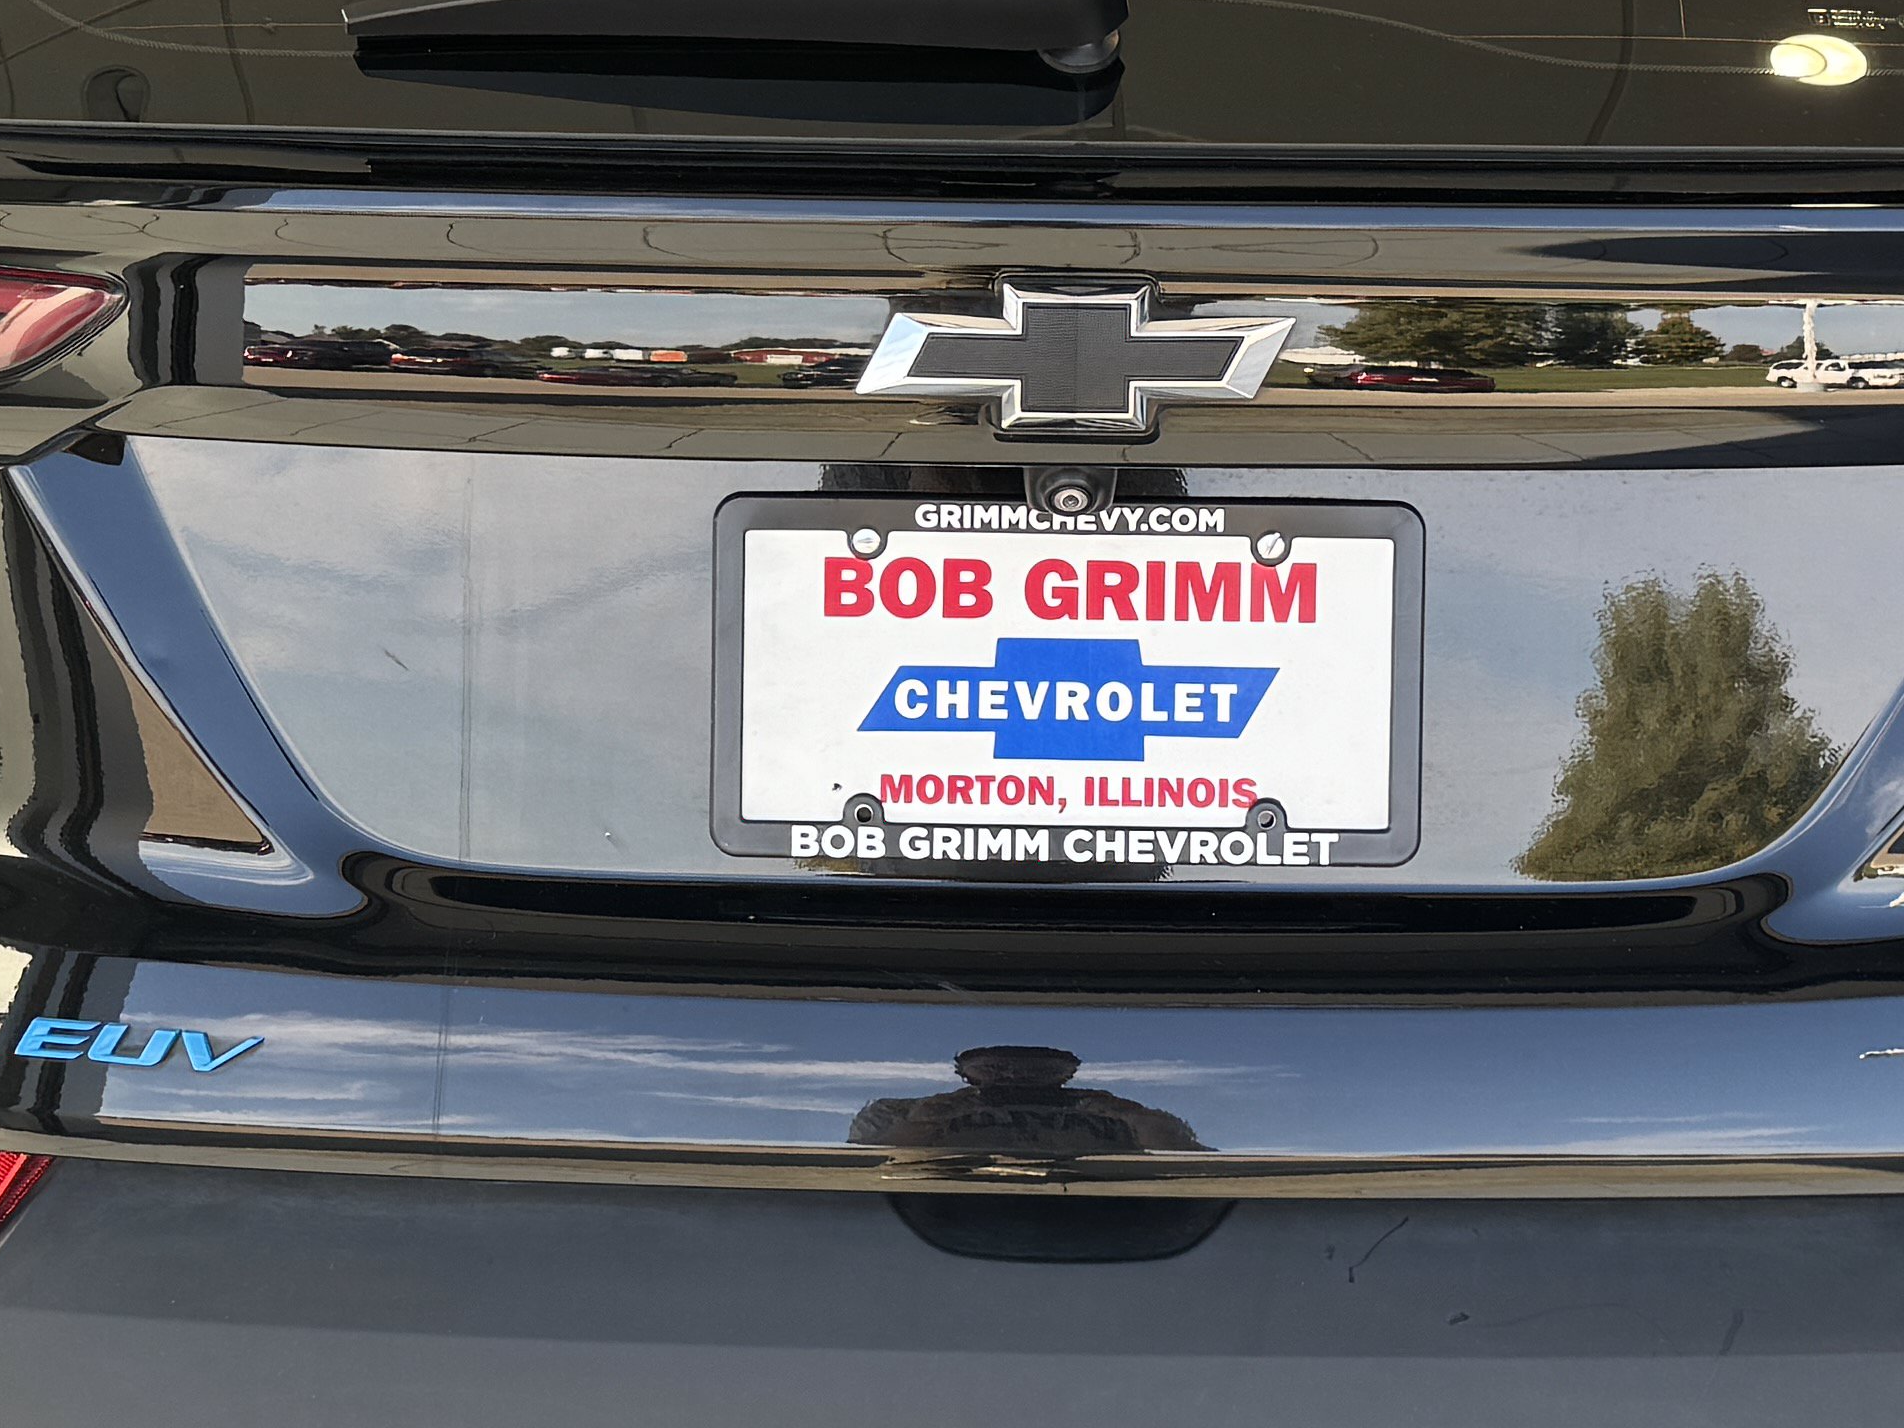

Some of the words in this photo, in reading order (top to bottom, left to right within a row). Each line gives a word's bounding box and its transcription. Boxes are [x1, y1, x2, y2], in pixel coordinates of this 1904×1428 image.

[914, 502, 1226, 533] GRIMMCHEVY.COM
[823, 556, 994, 619] BOB
[1024, 558, 1318, 623] GRIMM
[894, 678, 1238, 723] CHEVROLET
[879, 774, 1067, 814] MORTON,
[1084, 776, 1258, 809] ILLINOIS
[791, 824, 887, 860] BOB
[899, 827, 1050, 863] GRIMM
[1062, 829, 1340, 866] CHEVROLET
[14, 1015, 265, 1073] EUV
